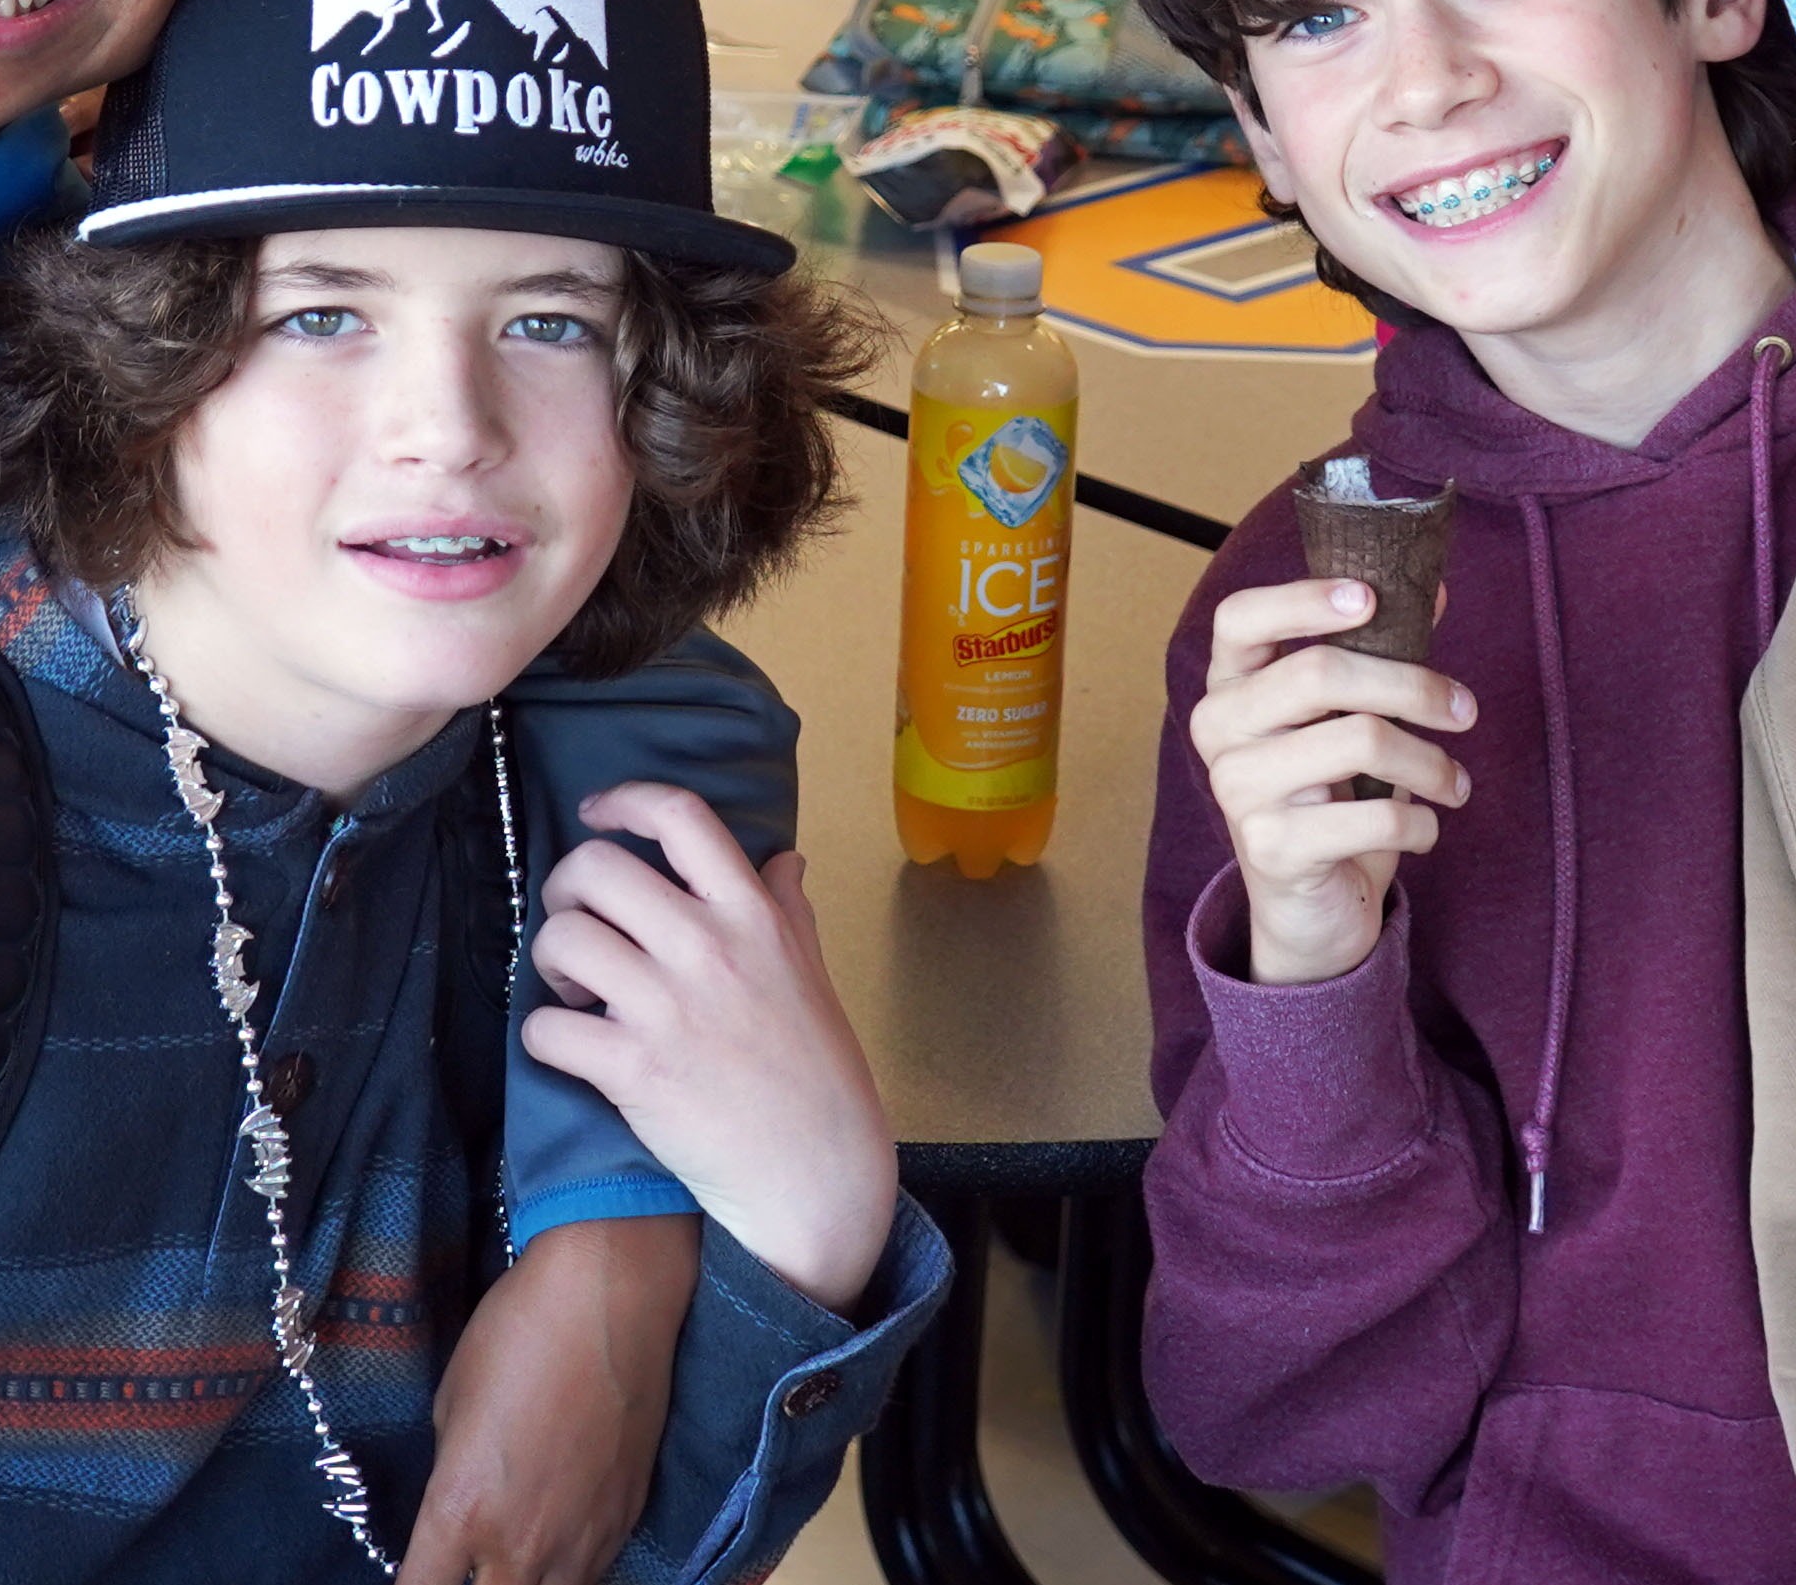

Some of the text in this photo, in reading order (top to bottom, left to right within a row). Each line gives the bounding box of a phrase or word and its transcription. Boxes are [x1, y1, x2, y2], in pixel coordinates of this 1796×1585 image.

[311, 61, 613, 139] Cowpoke
[960, 537, 1060, 557] SPARKLIN
[959, 554, 1061, 618] ICE
[956, 705, 998, 723] ZERO
